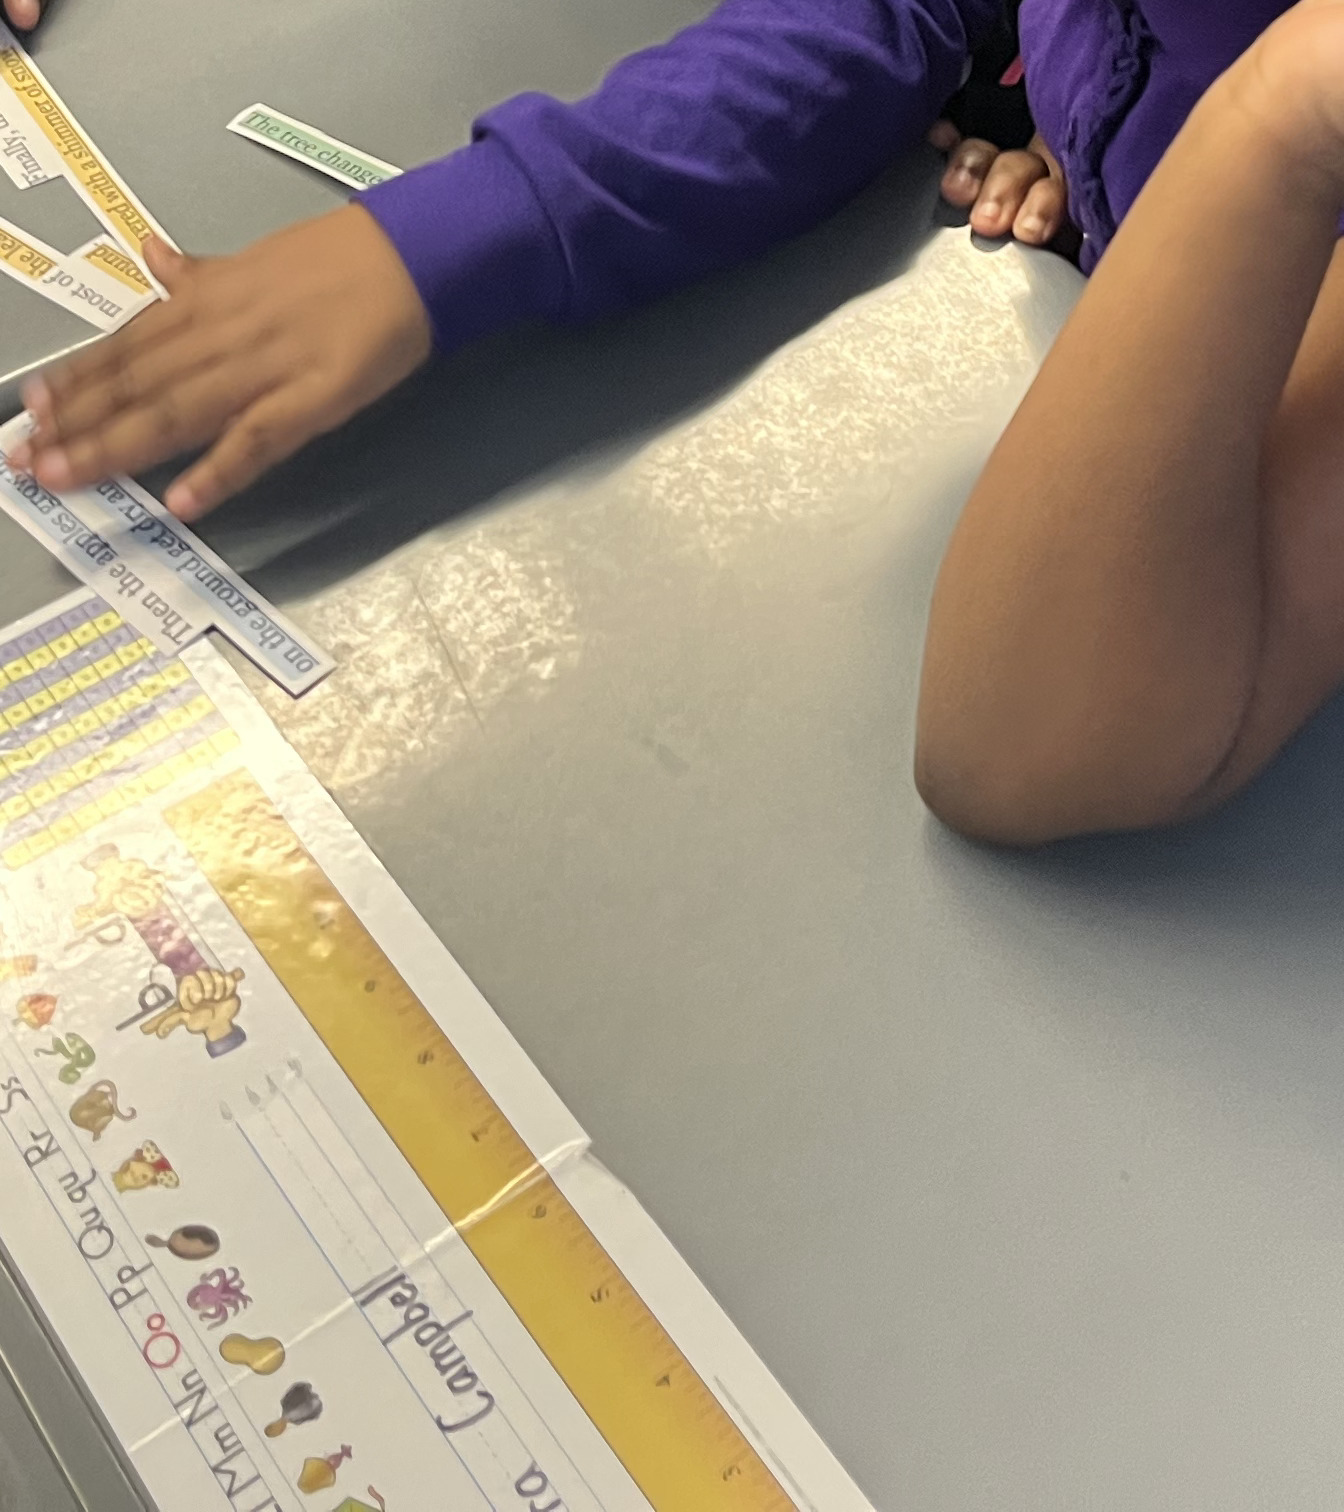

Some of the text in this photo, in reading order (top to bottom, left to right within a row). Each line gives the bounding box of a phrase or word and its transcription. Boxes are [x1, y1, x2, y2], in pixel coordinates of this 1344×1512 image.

[14, 82, 42, 102] of
[33, 98, 88, 160] shimmer
[243, 110, 279, 136] The
[279, 129, 316, 155] tree
[80, 159, 96, 172] a
[84, 170, 119, 203] with
[15, 247, 54, 279] the
[41, 267, 74, 293] of
[70, 282, 122, 320] most
[8, 472, 61, 512] grow
[94, 478, 124, 506] an
[52, 511, 116, 570] apples
[150, 529, 189, 559] get
[107, 560, 145, 602] the
[175, 554, 257, 619] ground
[139, 589, 193, 646] Then
[249, 614, 286, 654] the
[282, 644, 314, 676] on
[23, 1129, 61, 1171] Rr
[108, 1262, 155, 1311] Pp
[143, 1313, 181, 1369] Oo
[351, 1264, 495, 1434] Campbell
[173, 1369, 219, 1429] Nn
[212, 1421, 261, 1499] Mm
